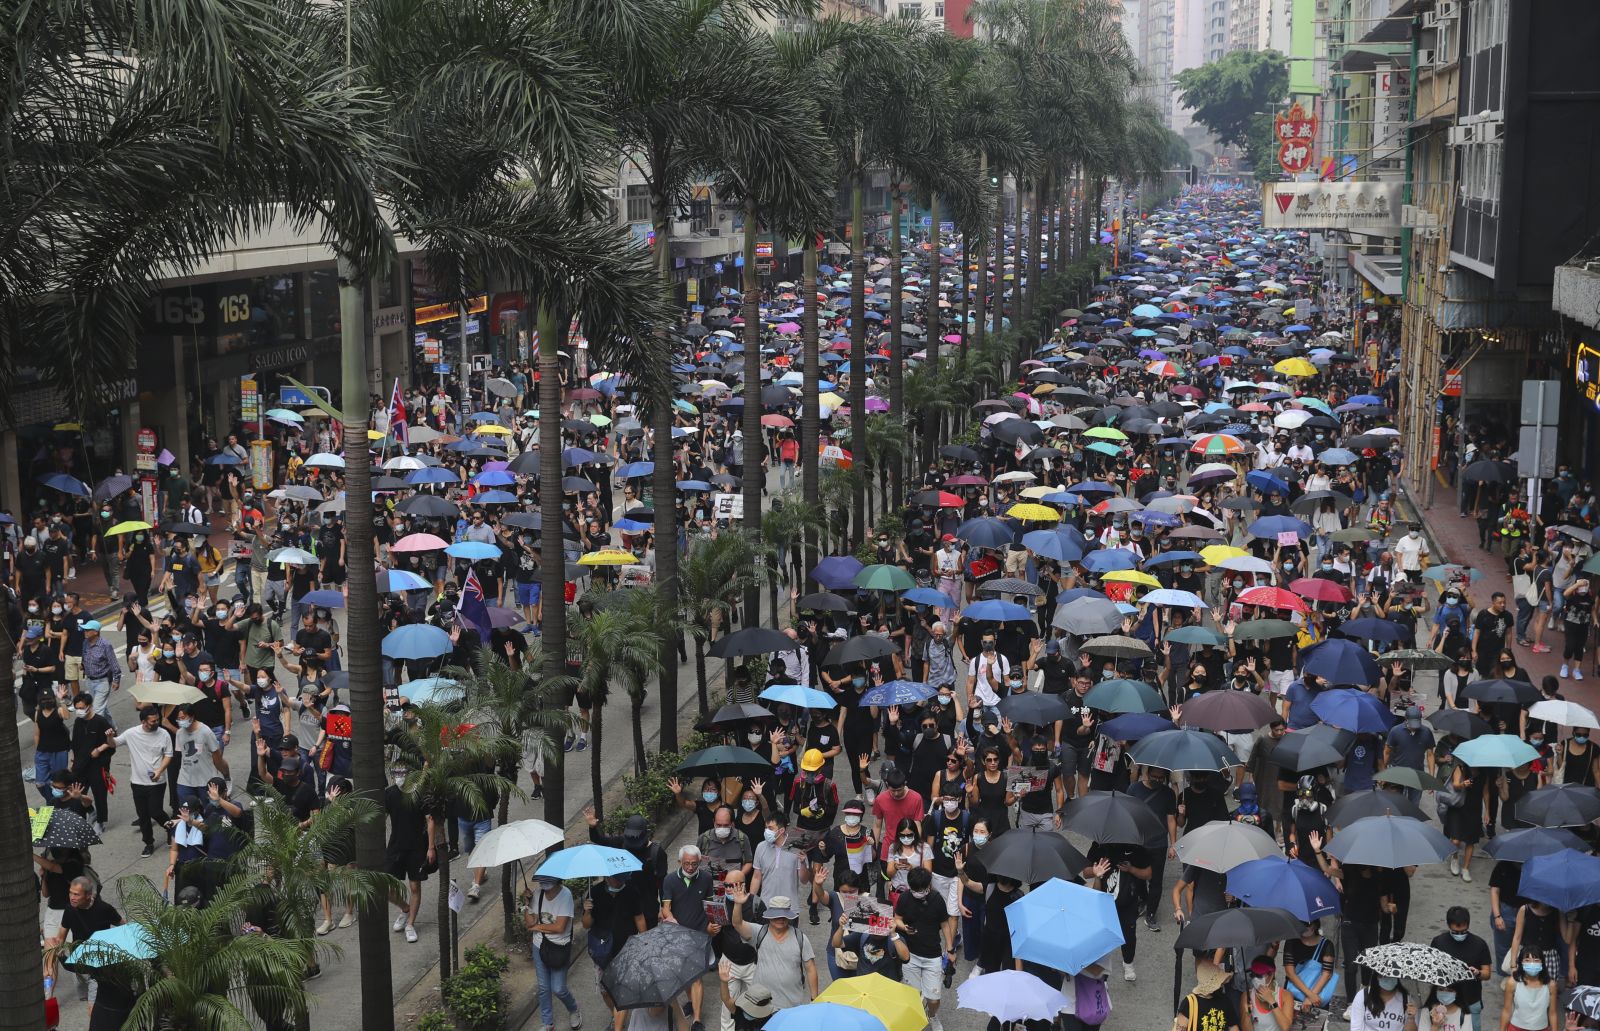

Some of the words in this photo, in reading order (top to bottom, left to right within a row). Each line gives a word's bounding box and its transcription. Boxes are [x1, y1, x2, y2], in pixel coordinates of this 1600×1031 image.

[1283, 144, 1307, 167] 押
[150, 297, 205, 324] 163
[219, 294, 249, 323] 163
[255, 350, 283, 369] SALON
[286, 346, 307, 363] ICON
[1379, 1020, 1391, 1029] 01
